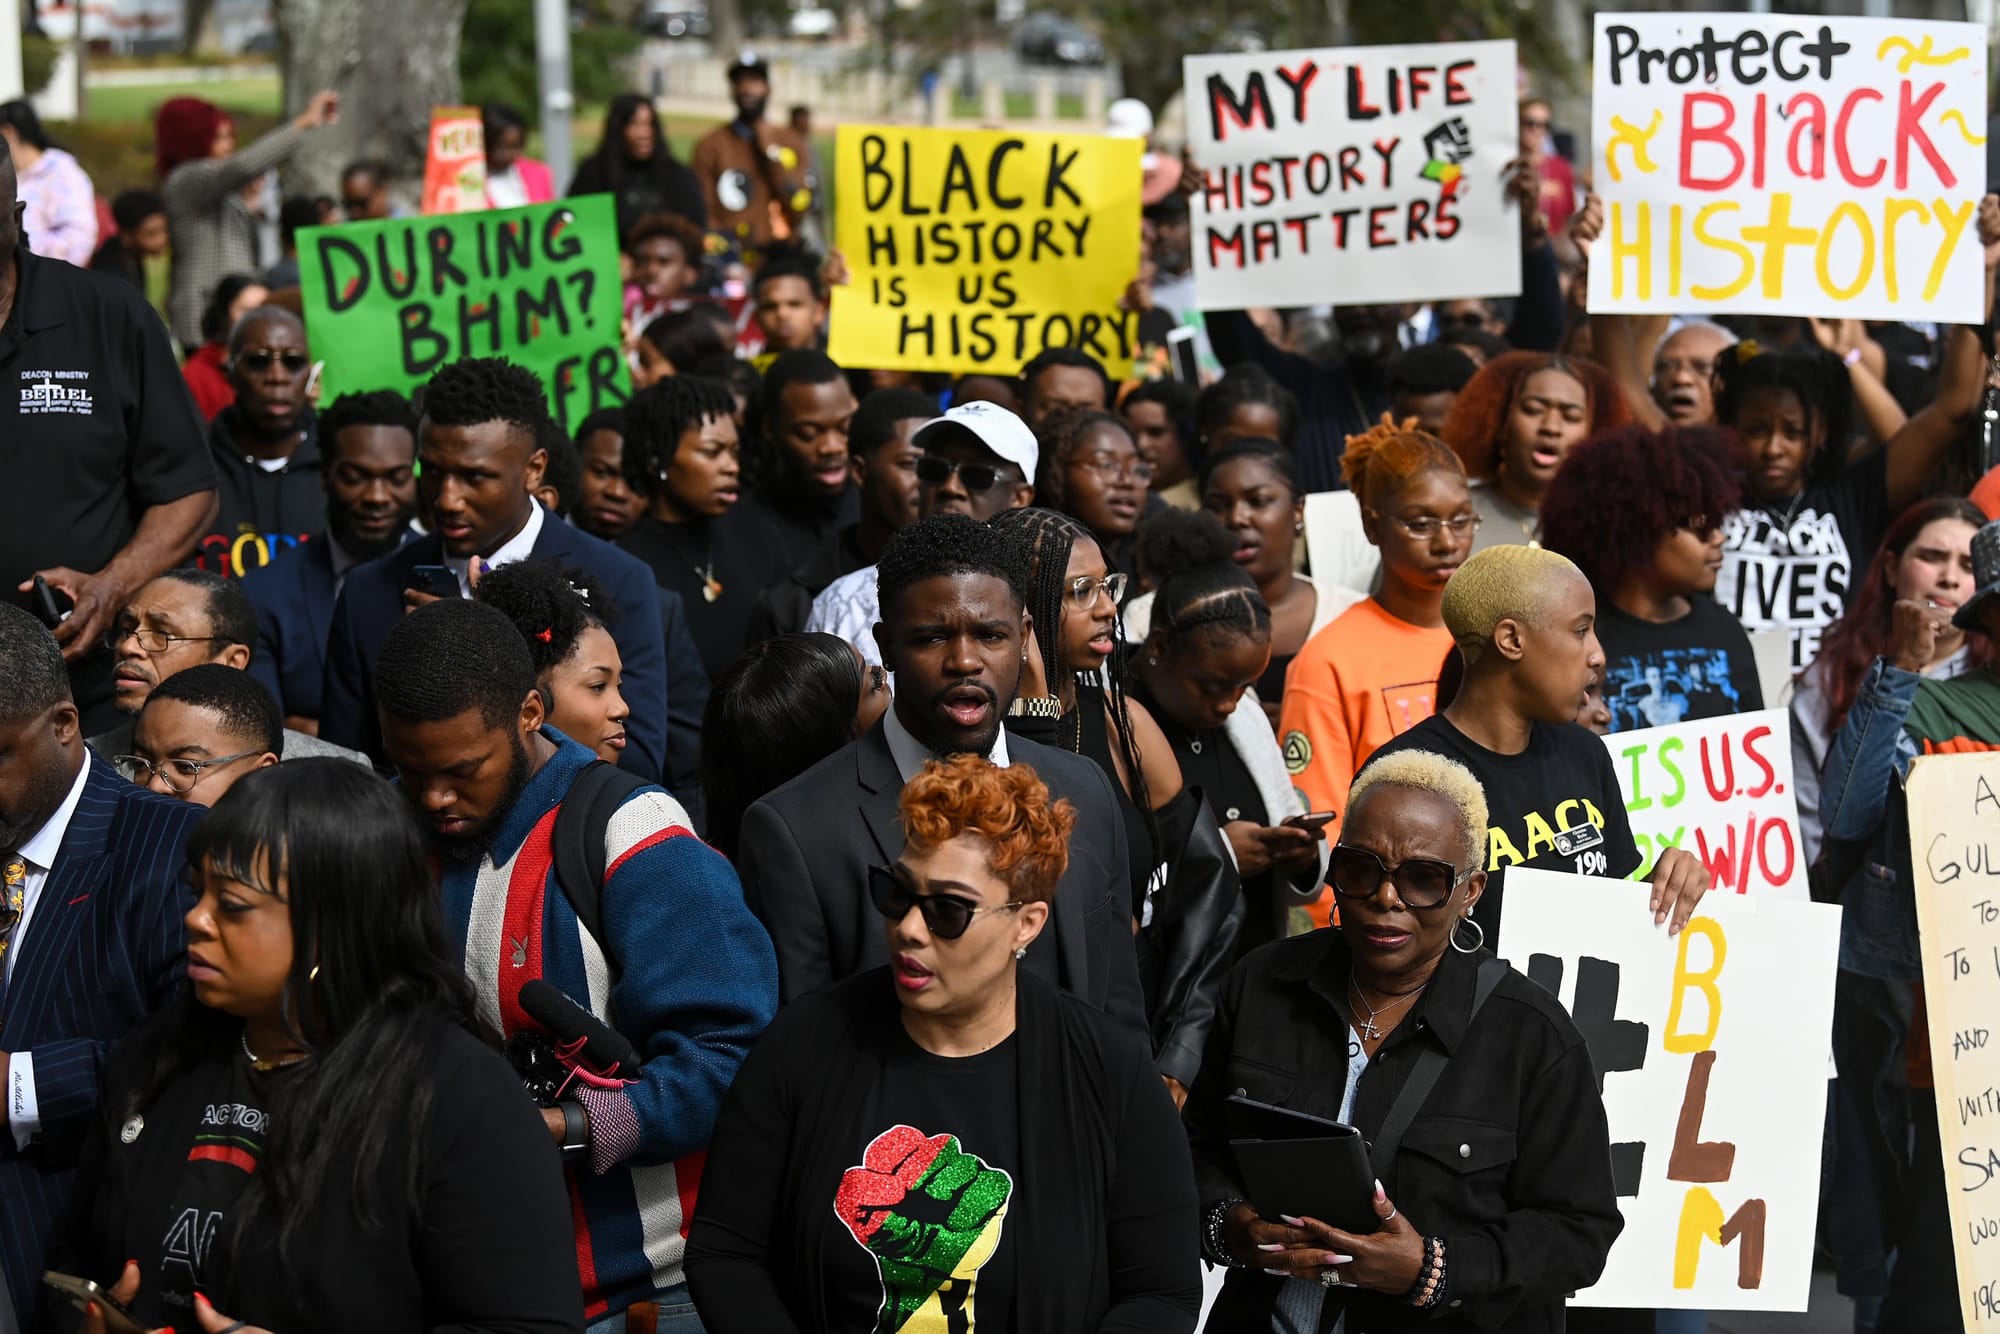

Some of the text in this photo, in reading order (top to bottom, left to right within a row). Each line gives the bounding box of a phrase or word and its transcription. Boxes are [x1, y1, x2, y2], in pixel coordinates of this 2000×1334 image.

[1605, 25, 1851, 86] Protect
[1207, 60, 1476, 141] MY LIFE
[862, 134, 1082, 216] BLACK
[1203, 137, 1401, 212] HISTORY
[316, 207, 583, 314] DURING
[868, 216, 1091, 266] HISTORY
[1206, 195, 1462, 270] MATTERS
[874, 270, 1017, 309] IS US
[398, 267, 596, 375] BHM?
[898, 307, 1131, 362] HISTORY
[20, 384, 93, 403] BETHEL
[21, 370, 90, 380] DEACON MINISTRY
[1734, 560, 1847, 619] IVES
[1622, 726, 1785, 813] IS U.S.
[1695, 811, 1796, 895] W/O
[1953, 1028, 1990, 1061] AND
[201, 1104, 270, 1135] ACTION
[1968, 1216, 2000, 1246] WO
